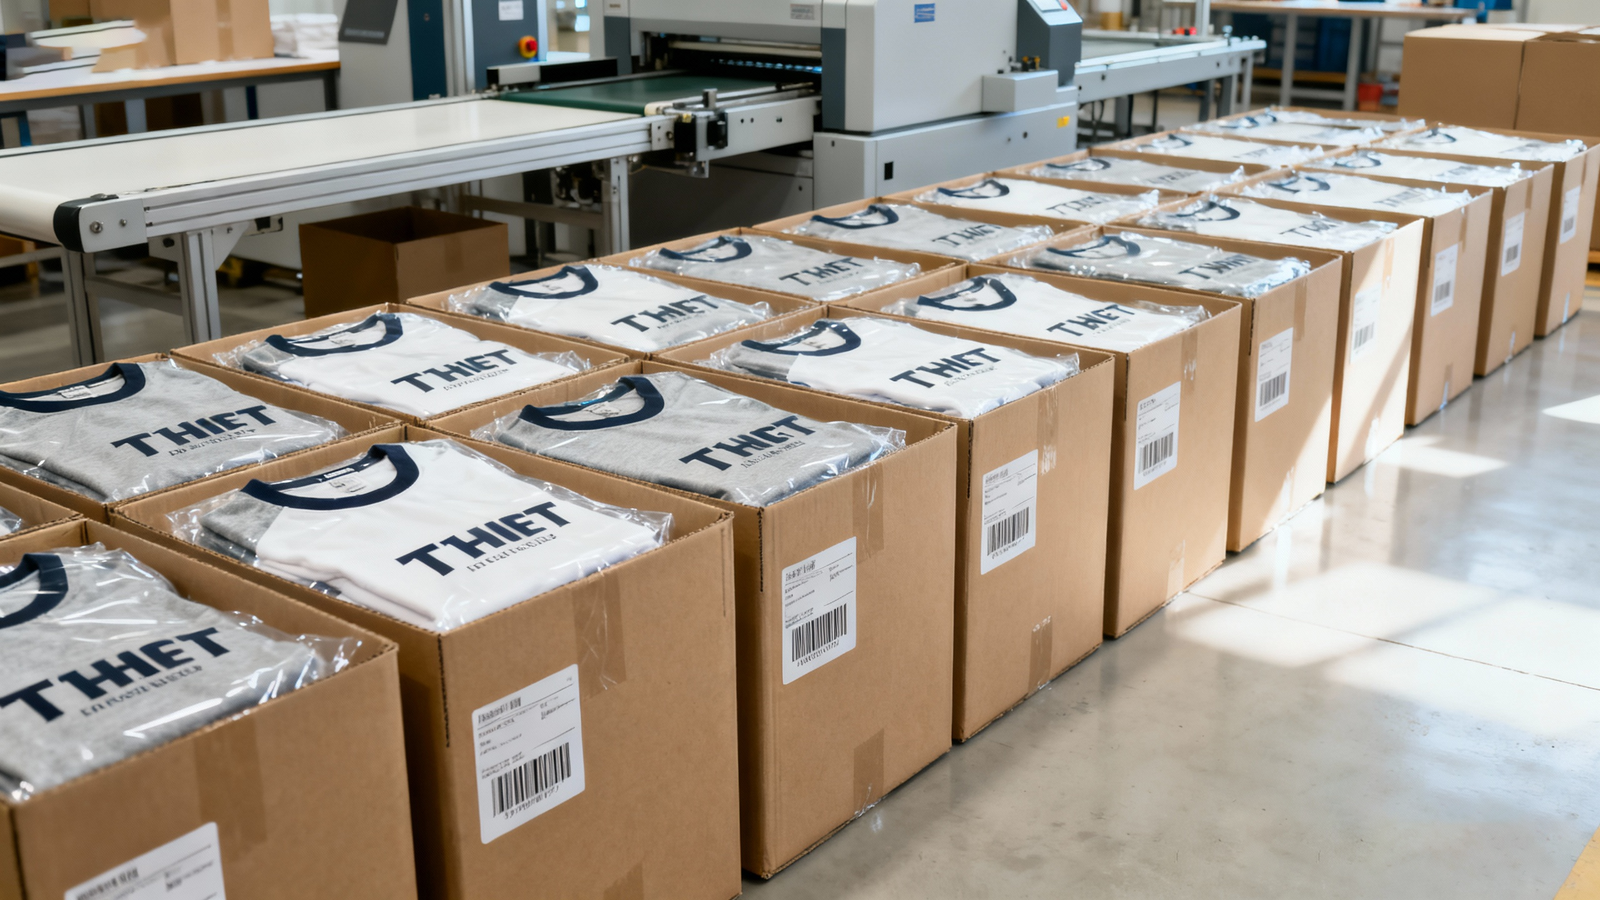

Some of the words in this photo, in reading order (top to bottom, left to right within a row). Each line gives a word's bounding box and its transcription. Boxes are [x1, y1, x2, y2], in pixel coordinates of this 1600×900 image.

[390, 348, 517, 393] THIET
[110, 404, 277, 458] THIET
[394, 501, 572, 577] THIET
